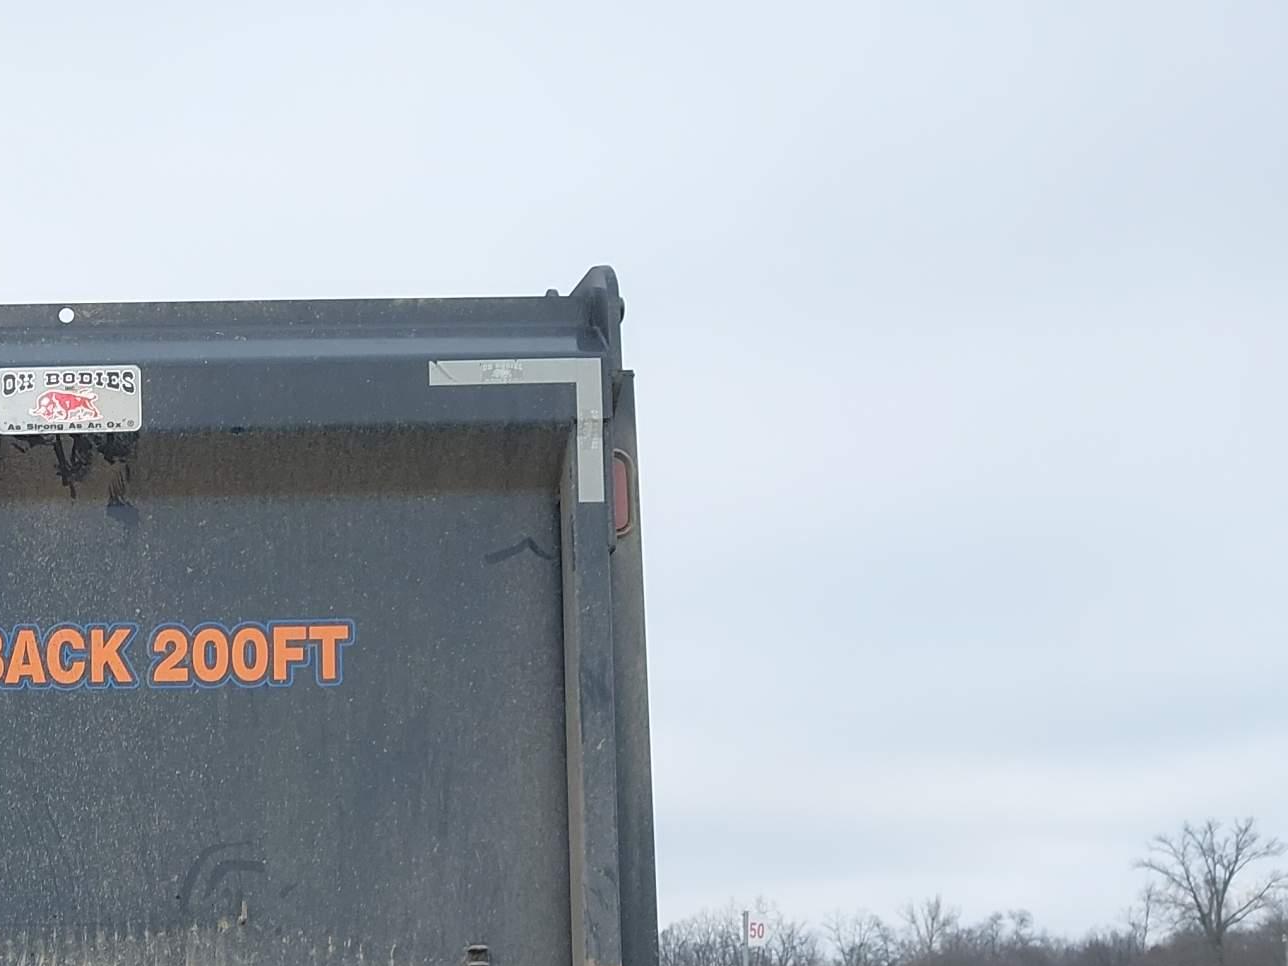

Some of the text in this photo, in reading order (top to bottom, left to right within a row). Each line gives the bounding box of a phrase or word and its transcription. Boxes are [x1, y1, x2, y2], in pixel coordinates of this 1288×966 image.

[3, 371, 134, 395] OX BODIES
[27, 422, 64, 432] Strong
[68, 422, 83, 430] As
[87, 421, 102, 429] An
[150, 624, 350, 683] 200FT
[749, 922, 765, 939] 50
